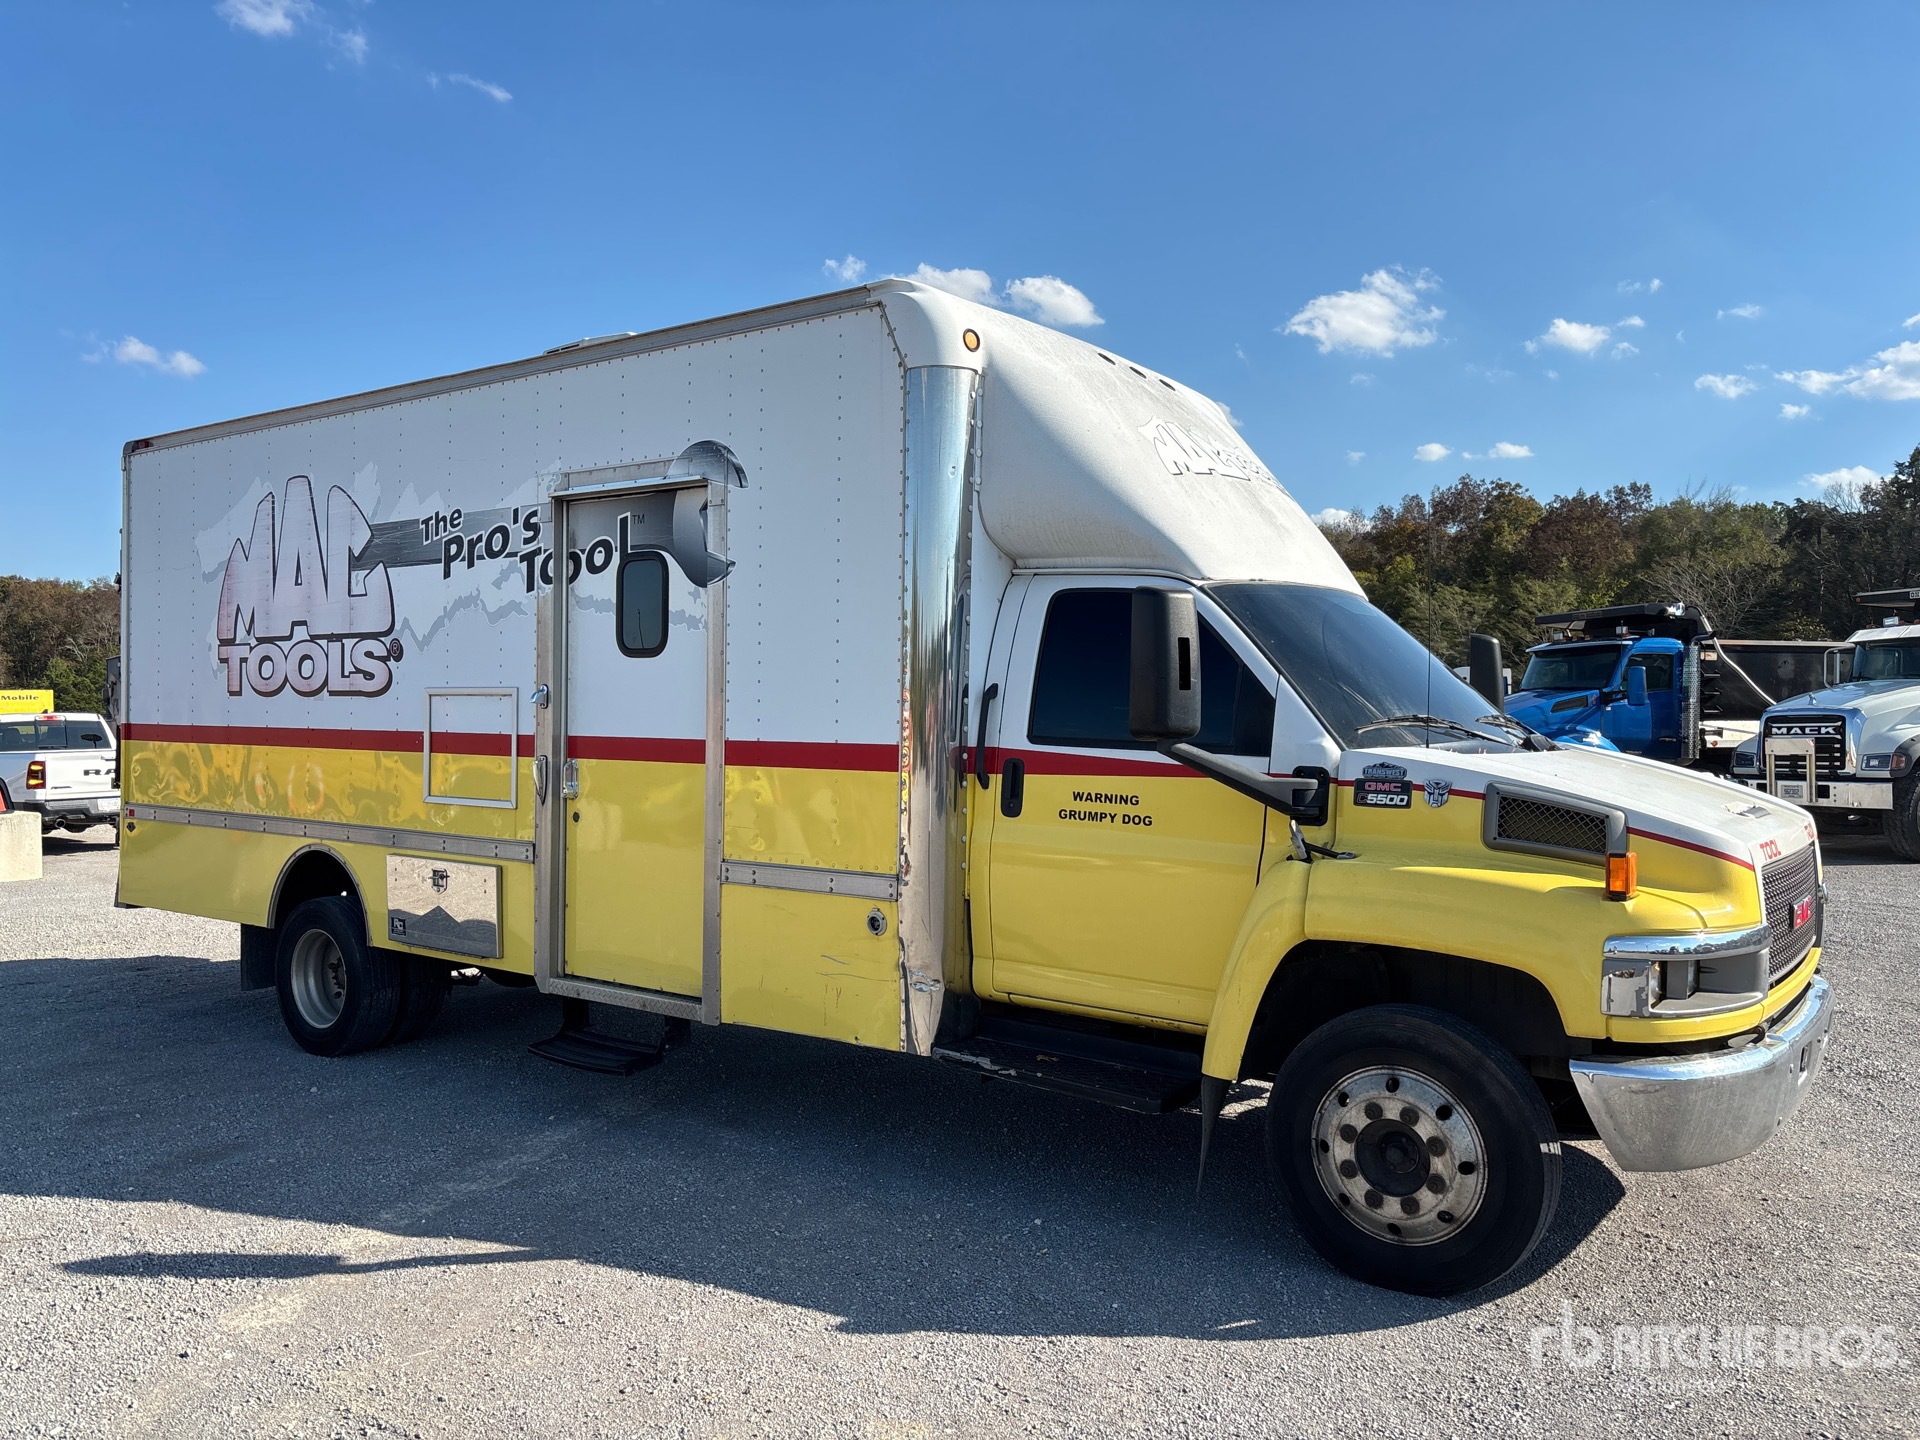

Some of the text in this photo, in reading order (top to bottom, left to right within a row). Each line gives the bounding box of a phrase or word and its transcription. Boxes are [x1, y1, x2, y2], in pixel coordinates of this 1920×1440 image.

[420, 507, 463, 544] The
[442, 505, 541, 580] Pro's
[216, 475, 396, 643] MAC
[518, 511, 630, 594] Tool
[1771, 726, 1836, 735] MACK
[83, 768, 116, 777] RA
[1364, 768, 1404, 777] TRANSWEST
[1364, 781, 1402, 792] GMC
[1072, 791, 1140, 806] WARNING
[1356, 792, 1409, 806] C5500
[1058, 809, 1153, 827] GRUMPY DOG
[1759, 838, 1782, 861] TOOL
